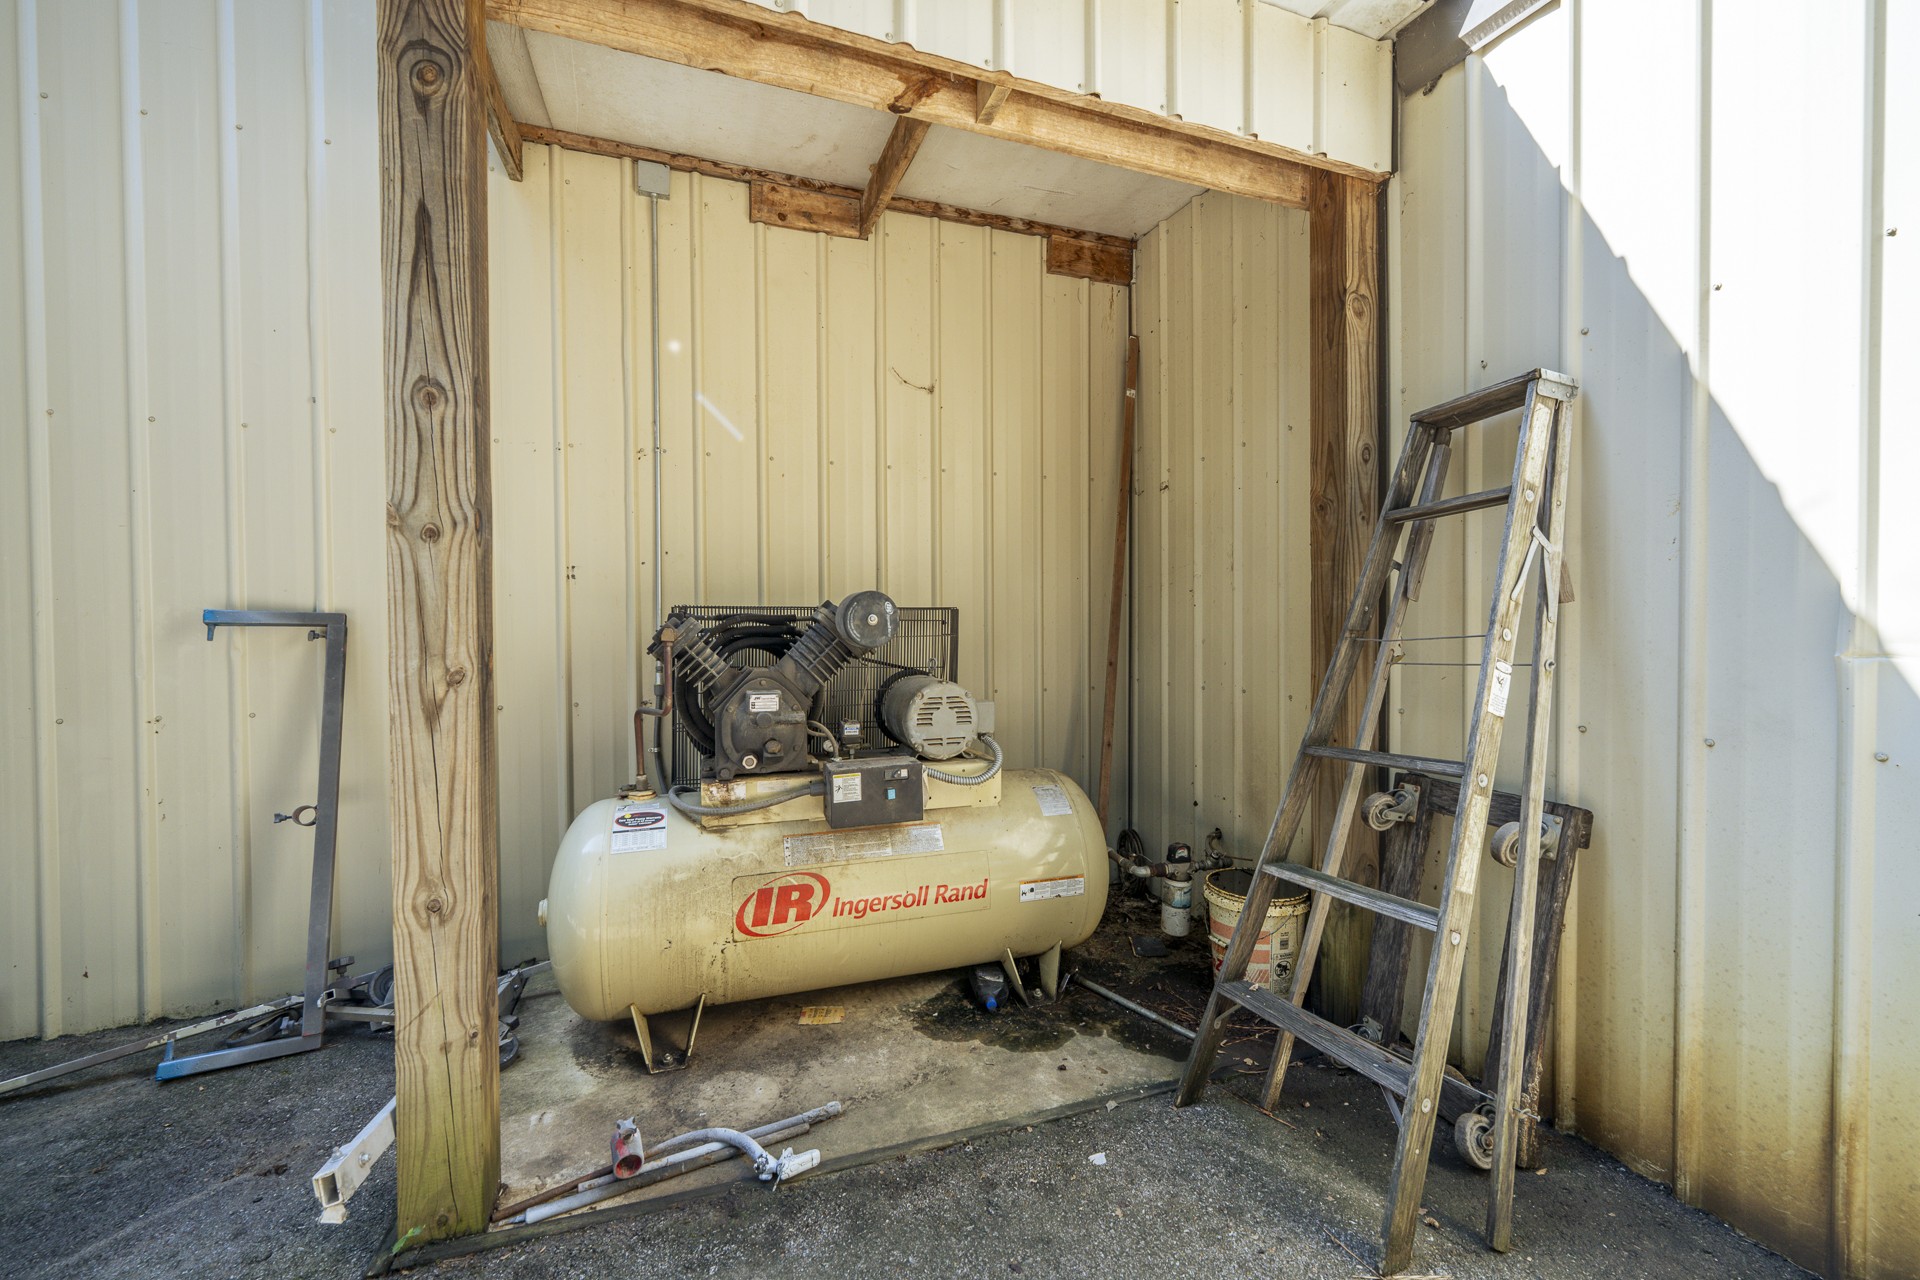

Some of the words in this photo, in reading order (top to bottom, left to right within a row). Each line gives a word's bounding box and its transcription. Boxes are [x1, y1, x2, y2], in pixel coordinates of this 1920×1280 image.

[749, 881, 818, 930] IR
[832, 884, 930, 925] Ingersoll
[933, 878, 989, 911] Rand
